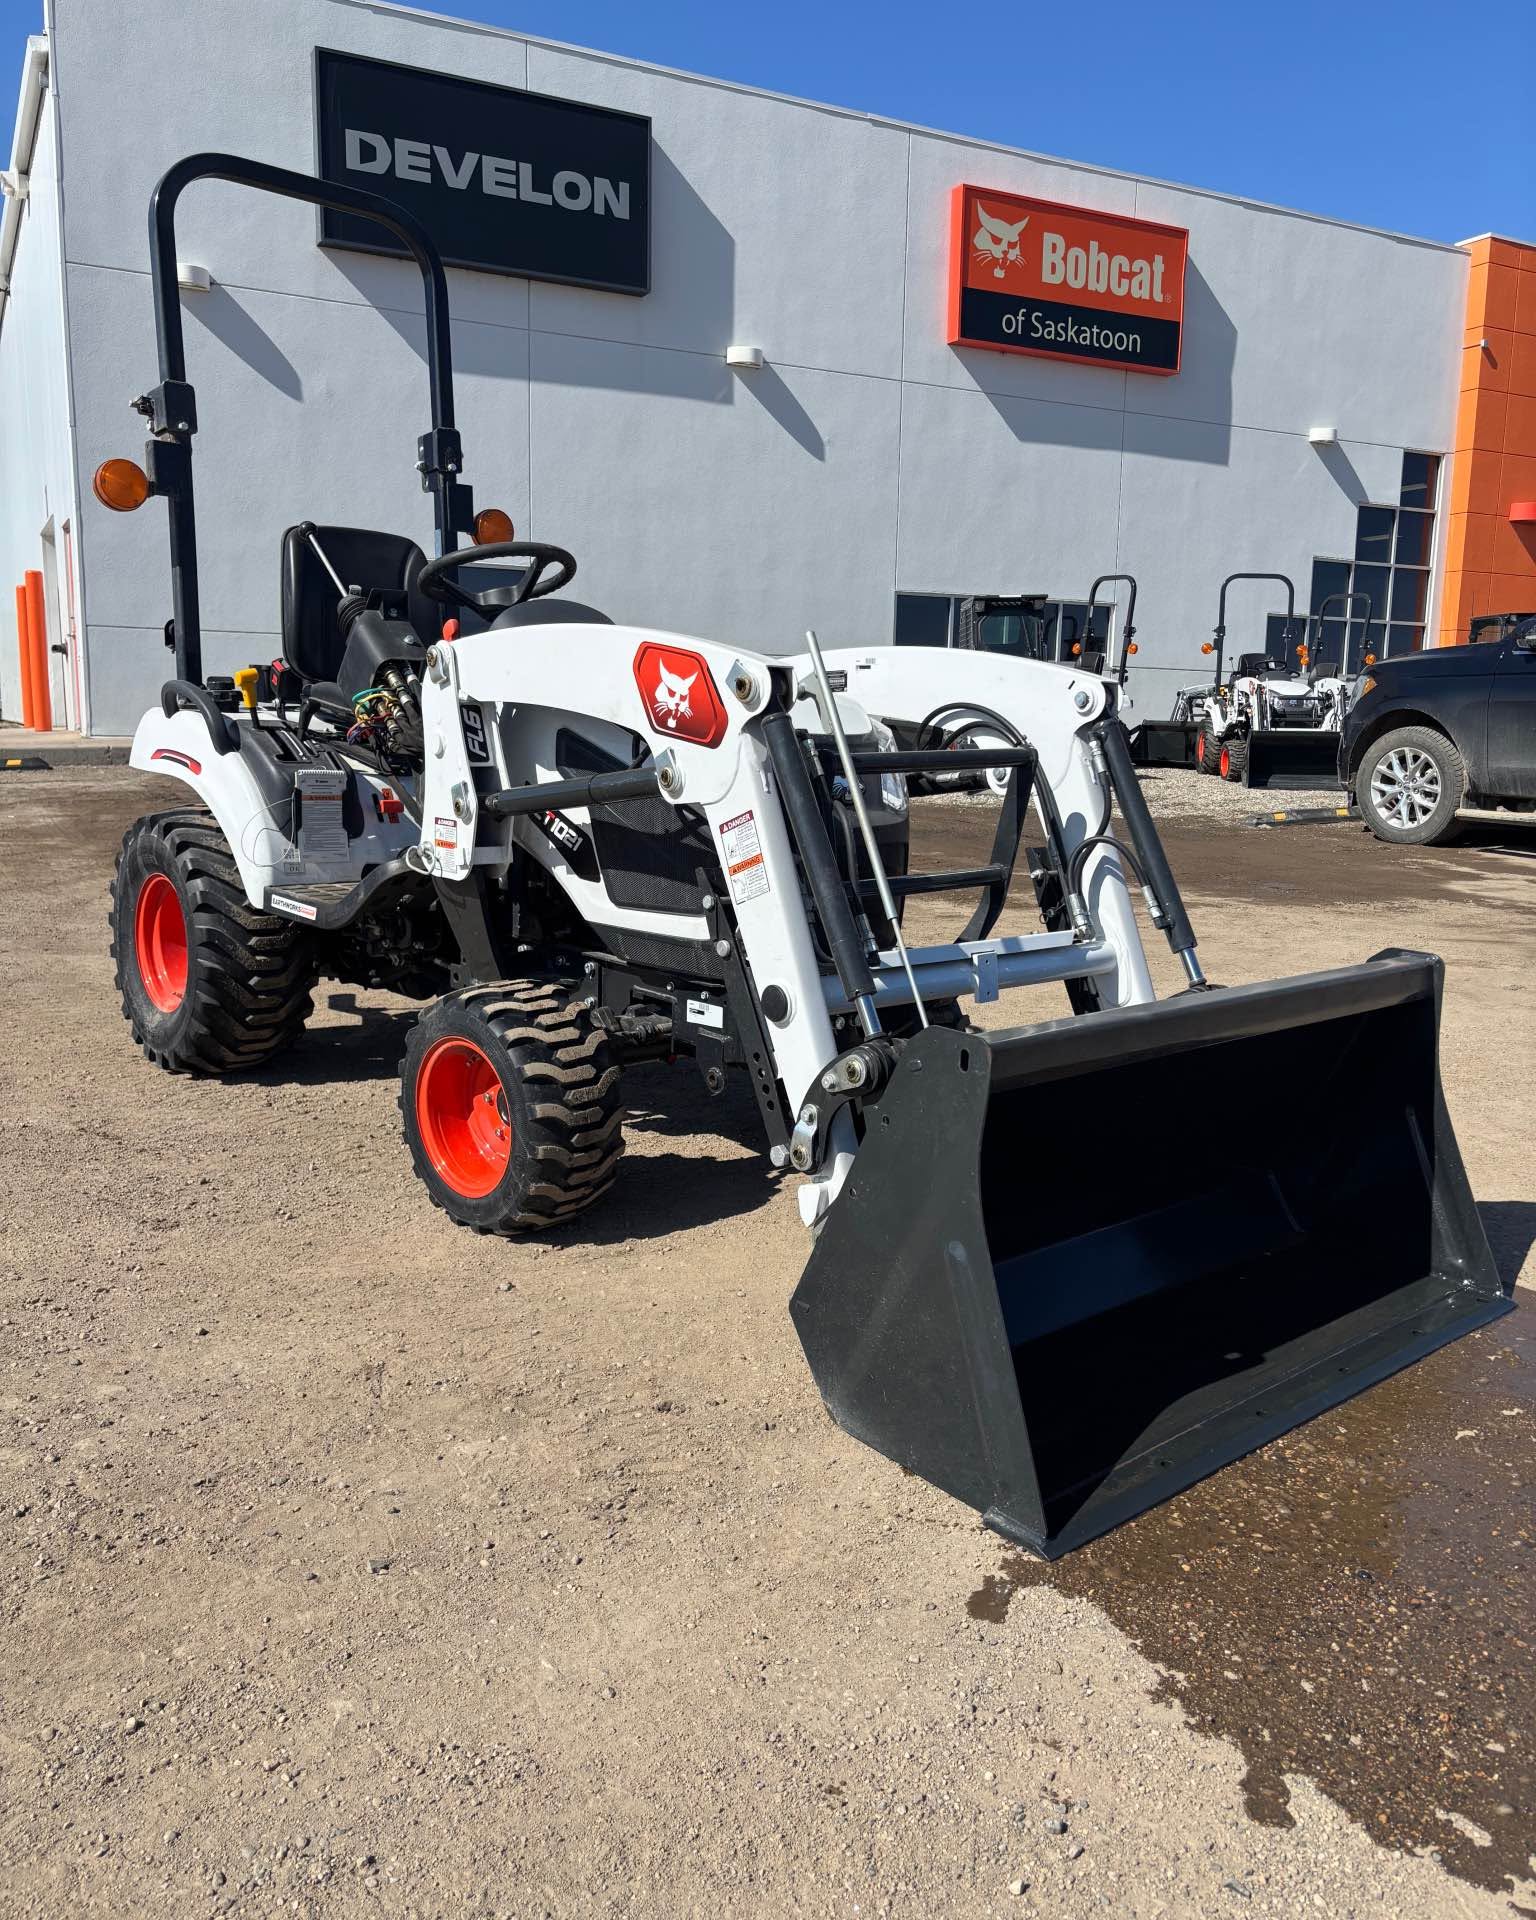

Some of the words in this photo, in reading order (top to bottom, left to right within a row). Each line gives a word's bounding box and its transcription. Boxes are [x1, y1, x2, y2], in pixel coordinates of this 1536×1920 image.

[345, 128, 630, 220] DEVELON
[1041, 231, 1165, 303] Bobcat
[1002, 308, 1027, 335] of
[1030, 311, 1141, 353] Saskatoon
[462, 707, 487, 758] FL6
[534, 810, 583, 851] T1021
[727, 813, 751, 829] DANGER
[736, 856, 760, 872] WARNING
